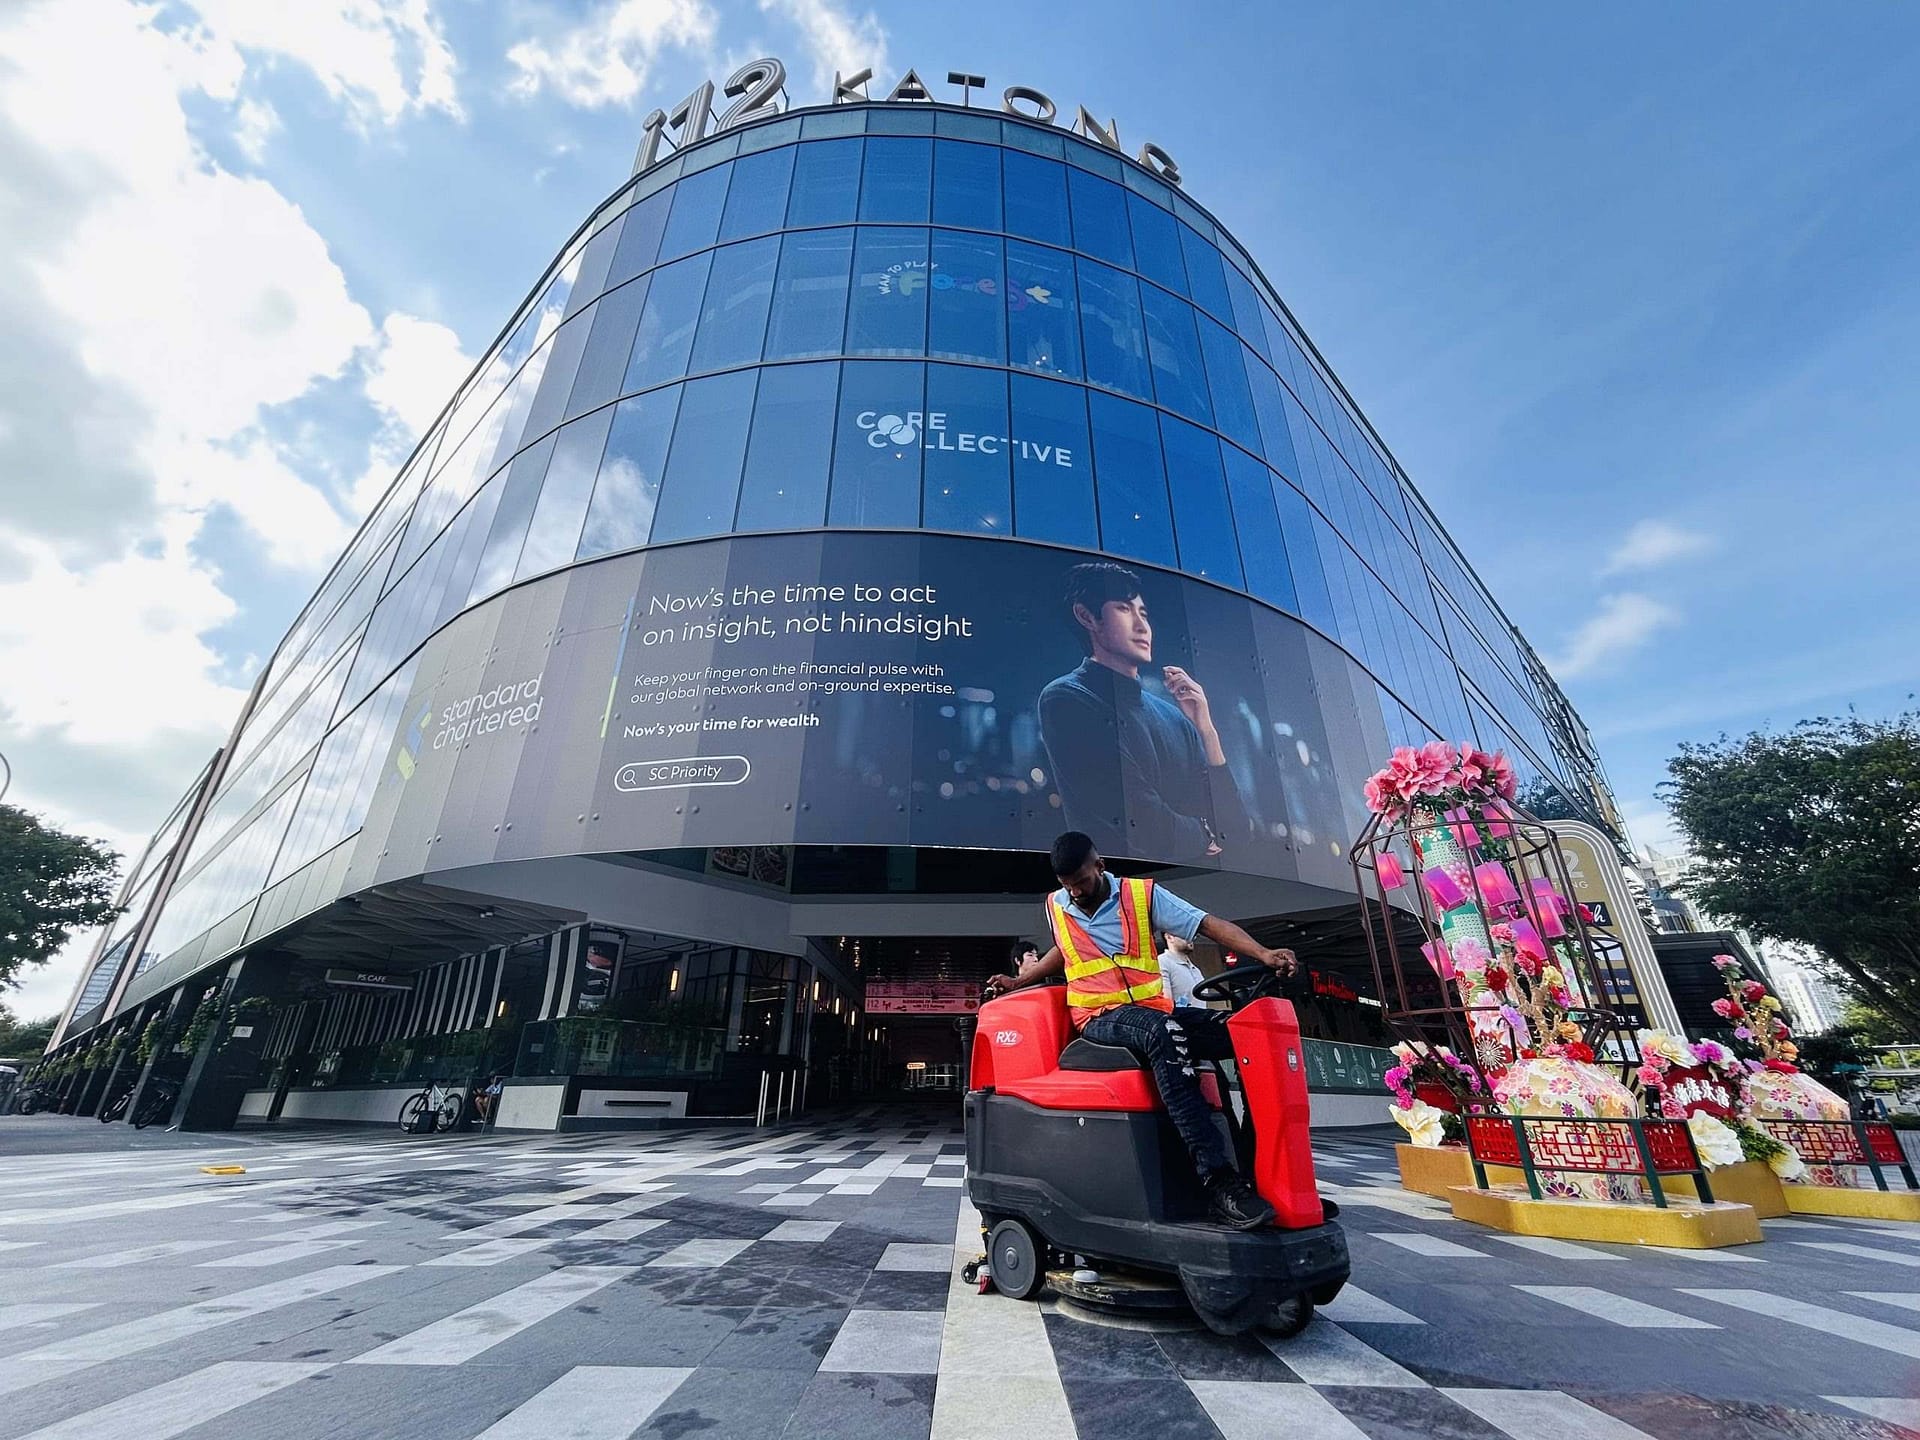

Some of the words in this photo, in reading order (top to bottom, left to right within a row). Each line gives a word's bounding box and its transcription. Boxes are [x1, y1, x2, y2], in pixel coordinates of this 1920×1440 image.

[832, 67, 1182, 185] KATONG
[887, 263, 902, 275] TO
[649, 587, 725, 616] Now's
[732, 584, 776, 607] the
[784, 583, 845, 604] time
[854, 583, 882, 602] to
[890, 585, 936, 604] act
[643, 628, 674, 646] on
[682, 614, 776, 644] insight,
[785, 612, 832, 634] not
[840, 610, 973, 641] hindsight
[634, 674, 669, 687] Keep
[671, 671, 702, 686] your
[704, 666, 747, 681] finger
[749, 667, 768, 676] on
[772, 663, 796, 676] the
[799, 661, 864, 675] financial
[868, 662, 908, 677] pulse
[911, 664, 944, 677] with
[439, 671, 543, 726] standard
[630, 693, 653, 704] our
[655, 684, 700, 704] global
[702, 683, 762, 697] network
[765, 680, 795, 693] and
[798, 679, 879, 695] on-ground
[883, 682, 956, 695] expertise.
[433, 695, 544, 750] chartered
[623, 722, 666, 738] Now's
[667, 722, 700, 737] your
[702, 717, 737, 731] time
[740, 716, 763, 729] for
[766, 713, 820, 730] wealth
[648, 766, 669, 781] SC
[670, 764, 722, 780] Priority
[995, 1031, 1017, 1044] RX2
